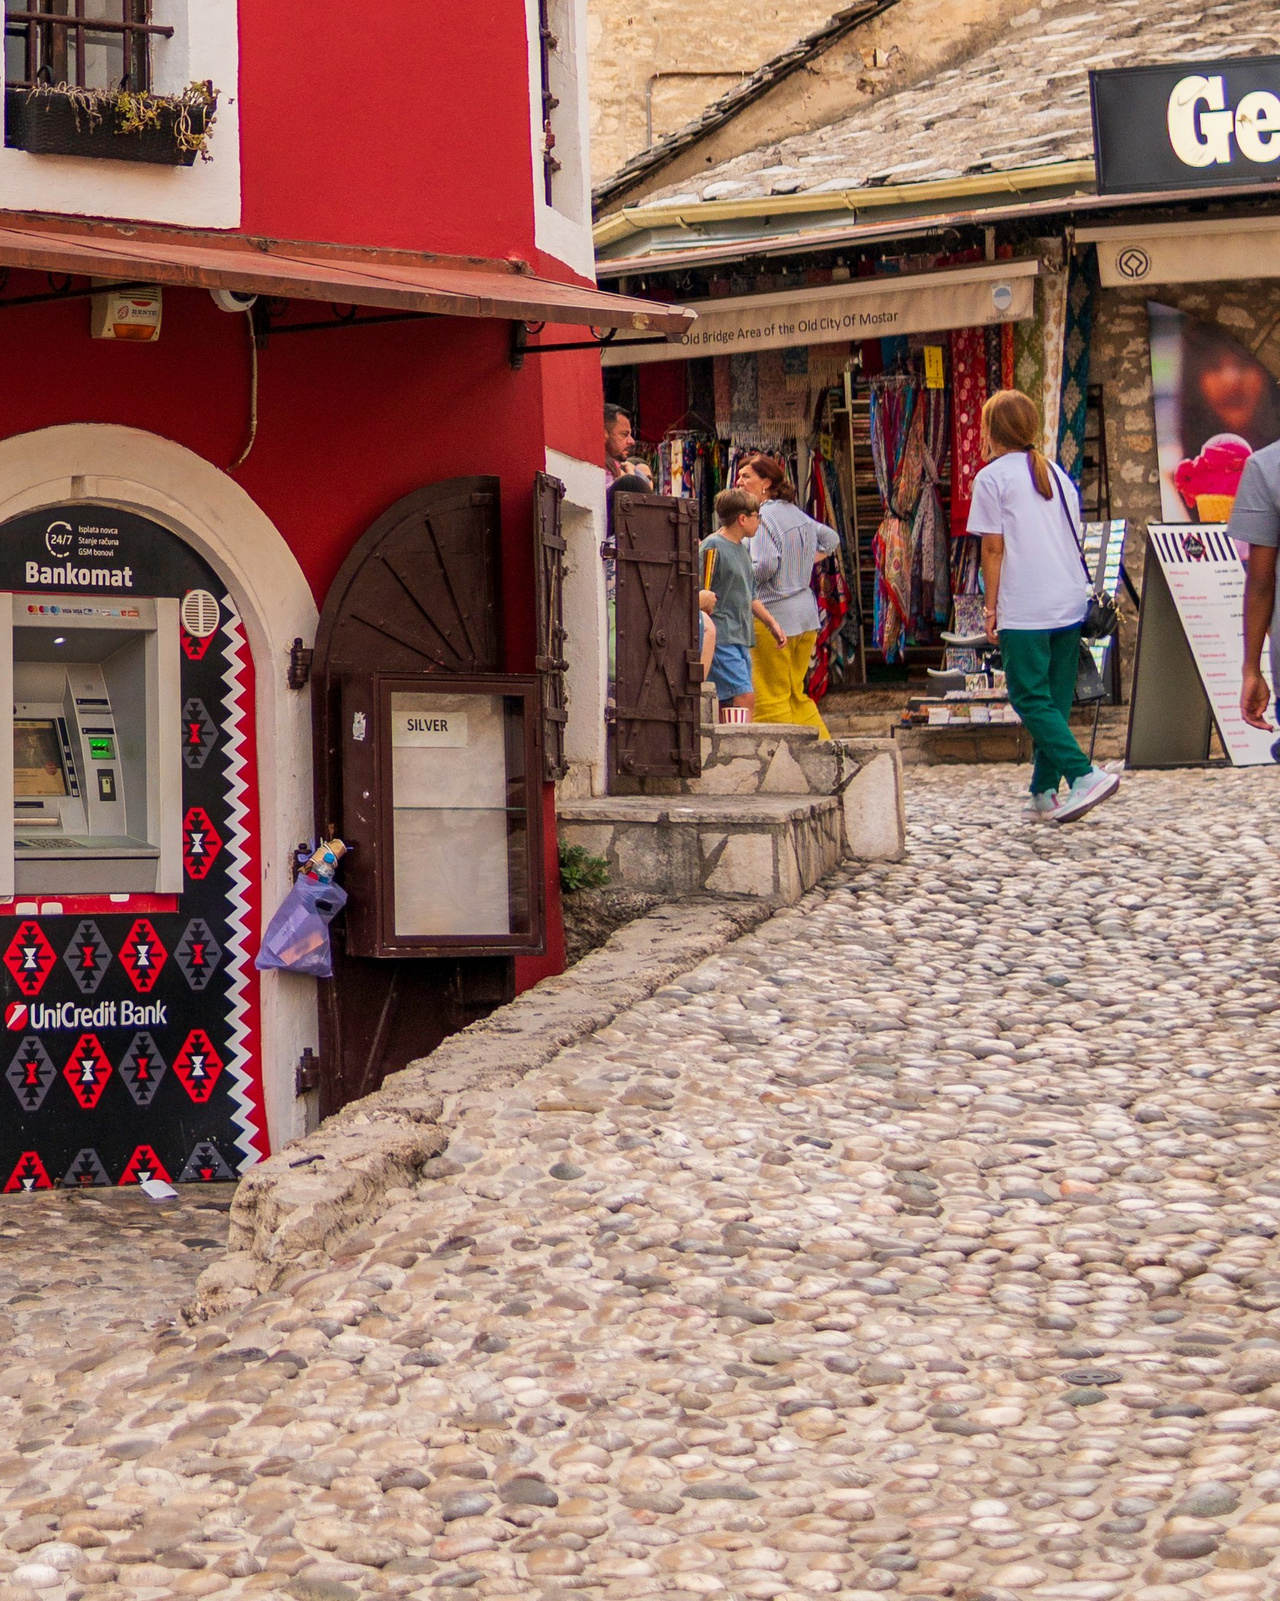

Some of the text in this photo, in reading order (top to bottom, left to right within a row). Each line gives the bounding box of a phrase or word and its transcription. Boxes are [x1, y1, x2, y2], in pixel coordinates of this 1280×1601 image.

[1166, 75, 1280, 168] Ge
[681, 311, 899, 345] Old Bridge Area of the Old City Of Mostar
[78, 525, 119, 535] Isplata novca
[50, 534, 73, 545] 24/7
[78, 536, 98, 546] Stanje
[78, 548, 114, 557] GSM bonovi
[25, 561, 133, 587] Bankomat
[407, 718, 449, 732] SILVER
[30, 999, 168, 1029] UniCredit Bank
